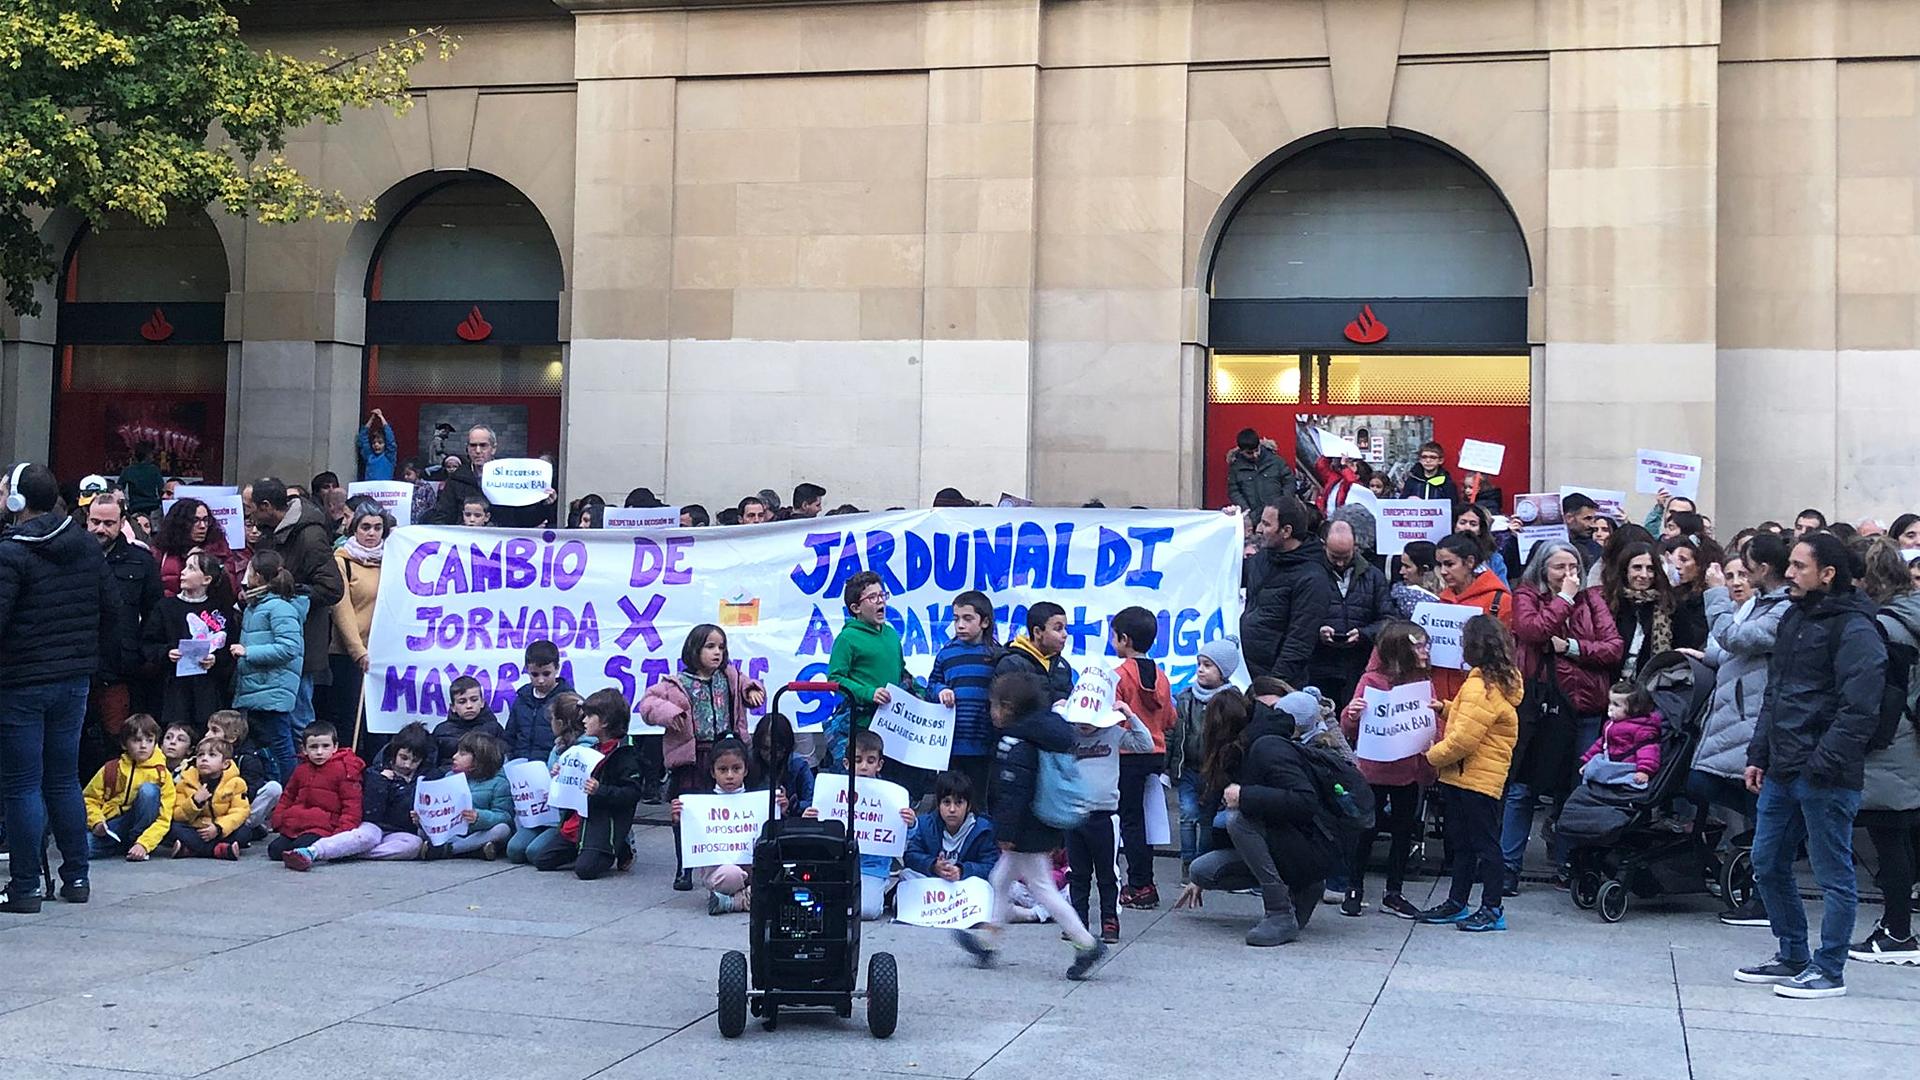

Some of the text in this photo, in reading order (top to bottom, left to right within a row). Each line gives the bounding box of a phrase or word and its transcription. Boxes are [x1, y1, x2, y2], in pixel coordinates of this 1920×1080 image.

[629, 536, 696, 588] DE
[405, 594, 667, 652] JORNADA X
[903, 709, 945, 729] RECURSOS!
[861, 797, 868, 807] A
[870, 798, 882, 808] LA
[733, 811, 740, 820] A
[742, 810, 755, 819] LA
